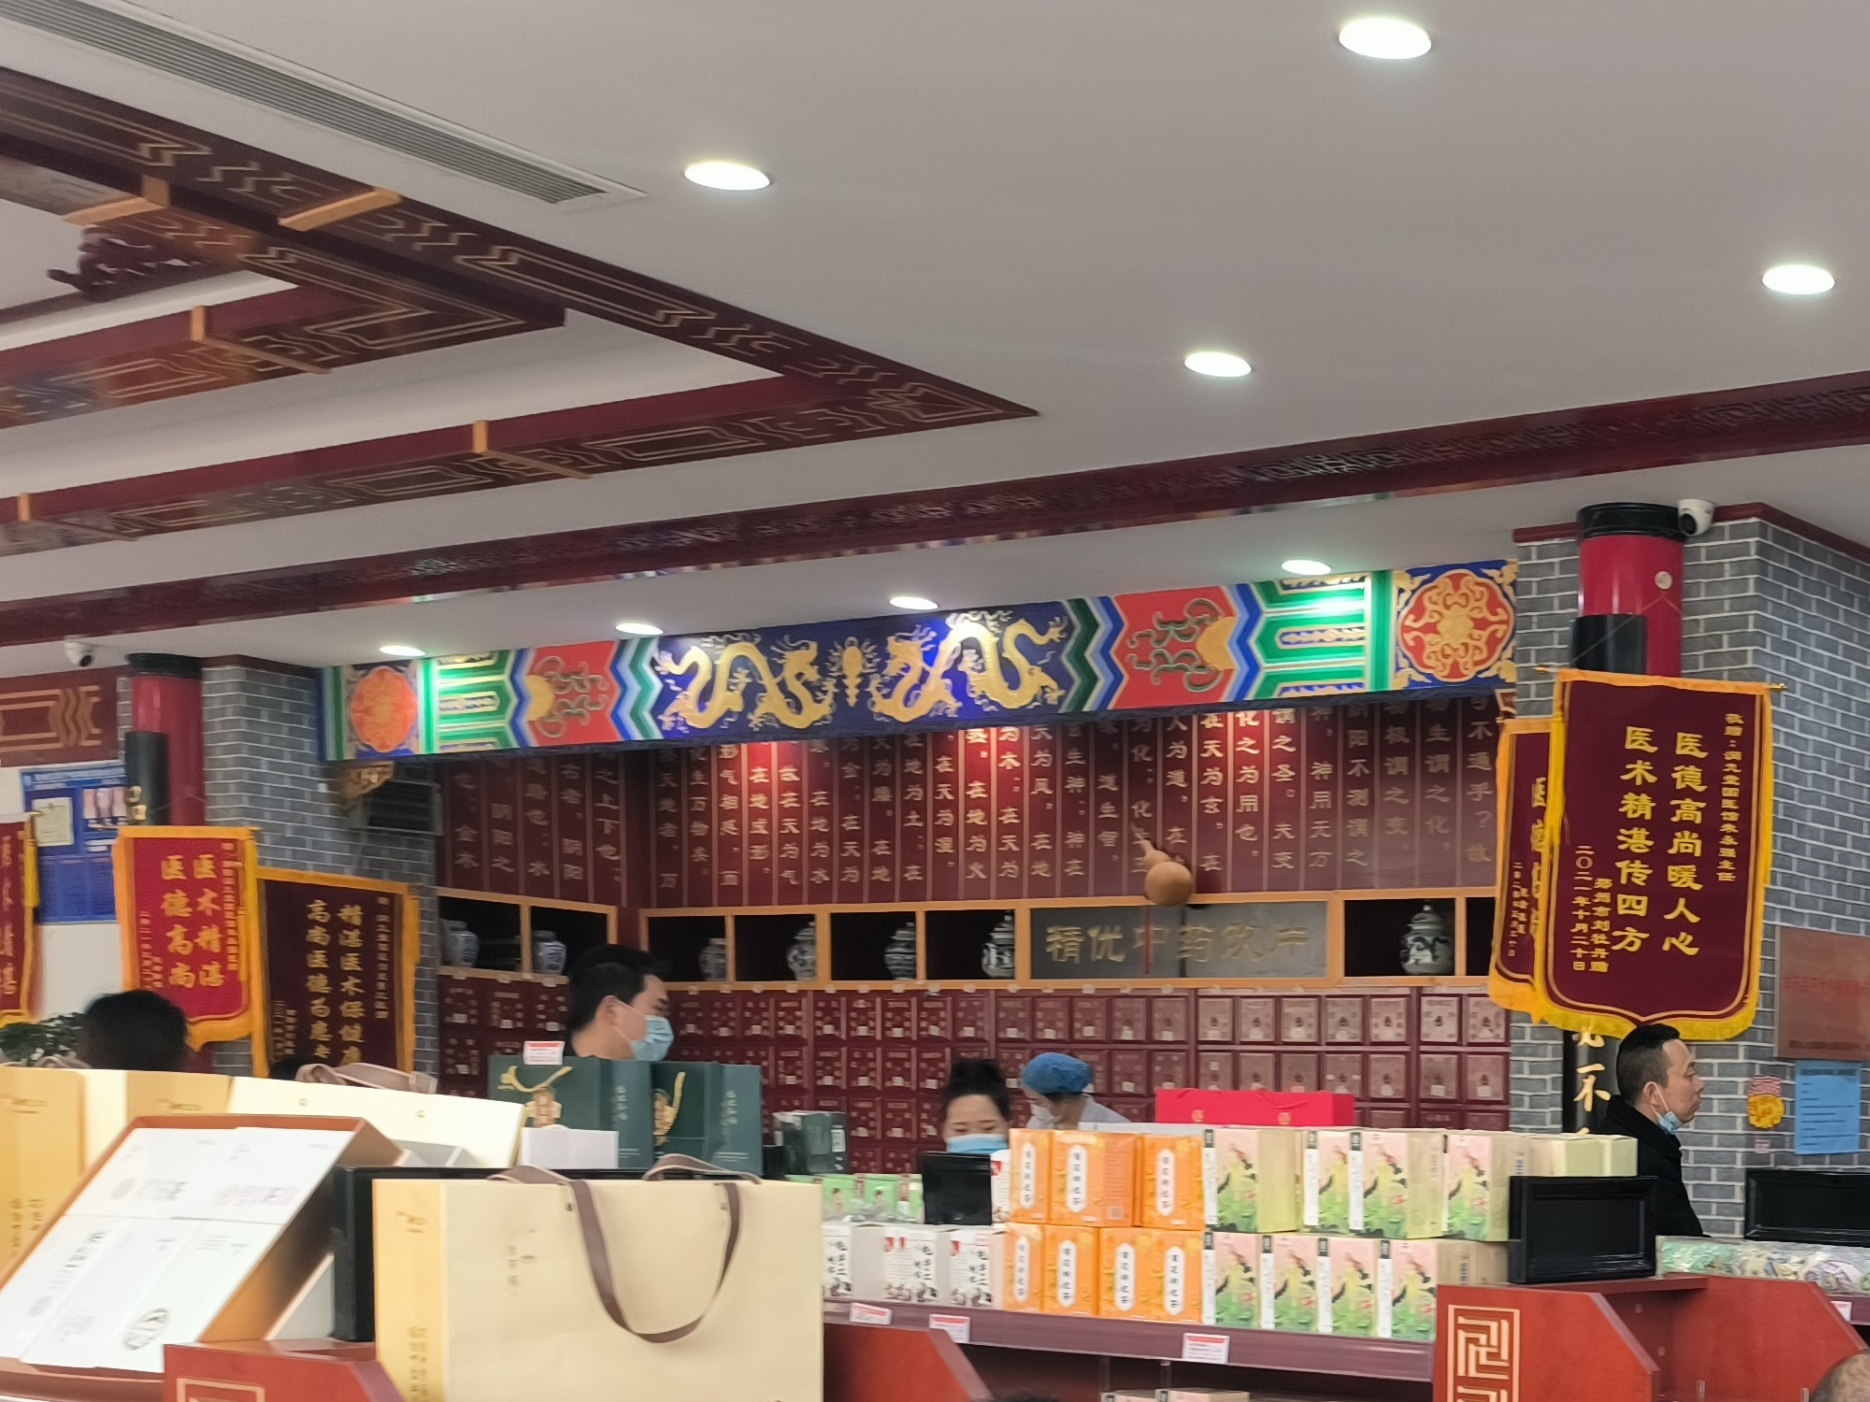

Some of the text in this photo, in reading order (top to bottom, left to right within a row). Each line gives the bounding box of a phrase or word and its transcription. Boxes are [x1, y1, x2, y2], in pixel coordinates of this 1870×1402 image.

[160, 854, 197, 989] 医德高尚
[1611, 726, 1658, 952] 医术精湛传四方
[1662, 732, 1709, 956] 医德高尚暖人心
